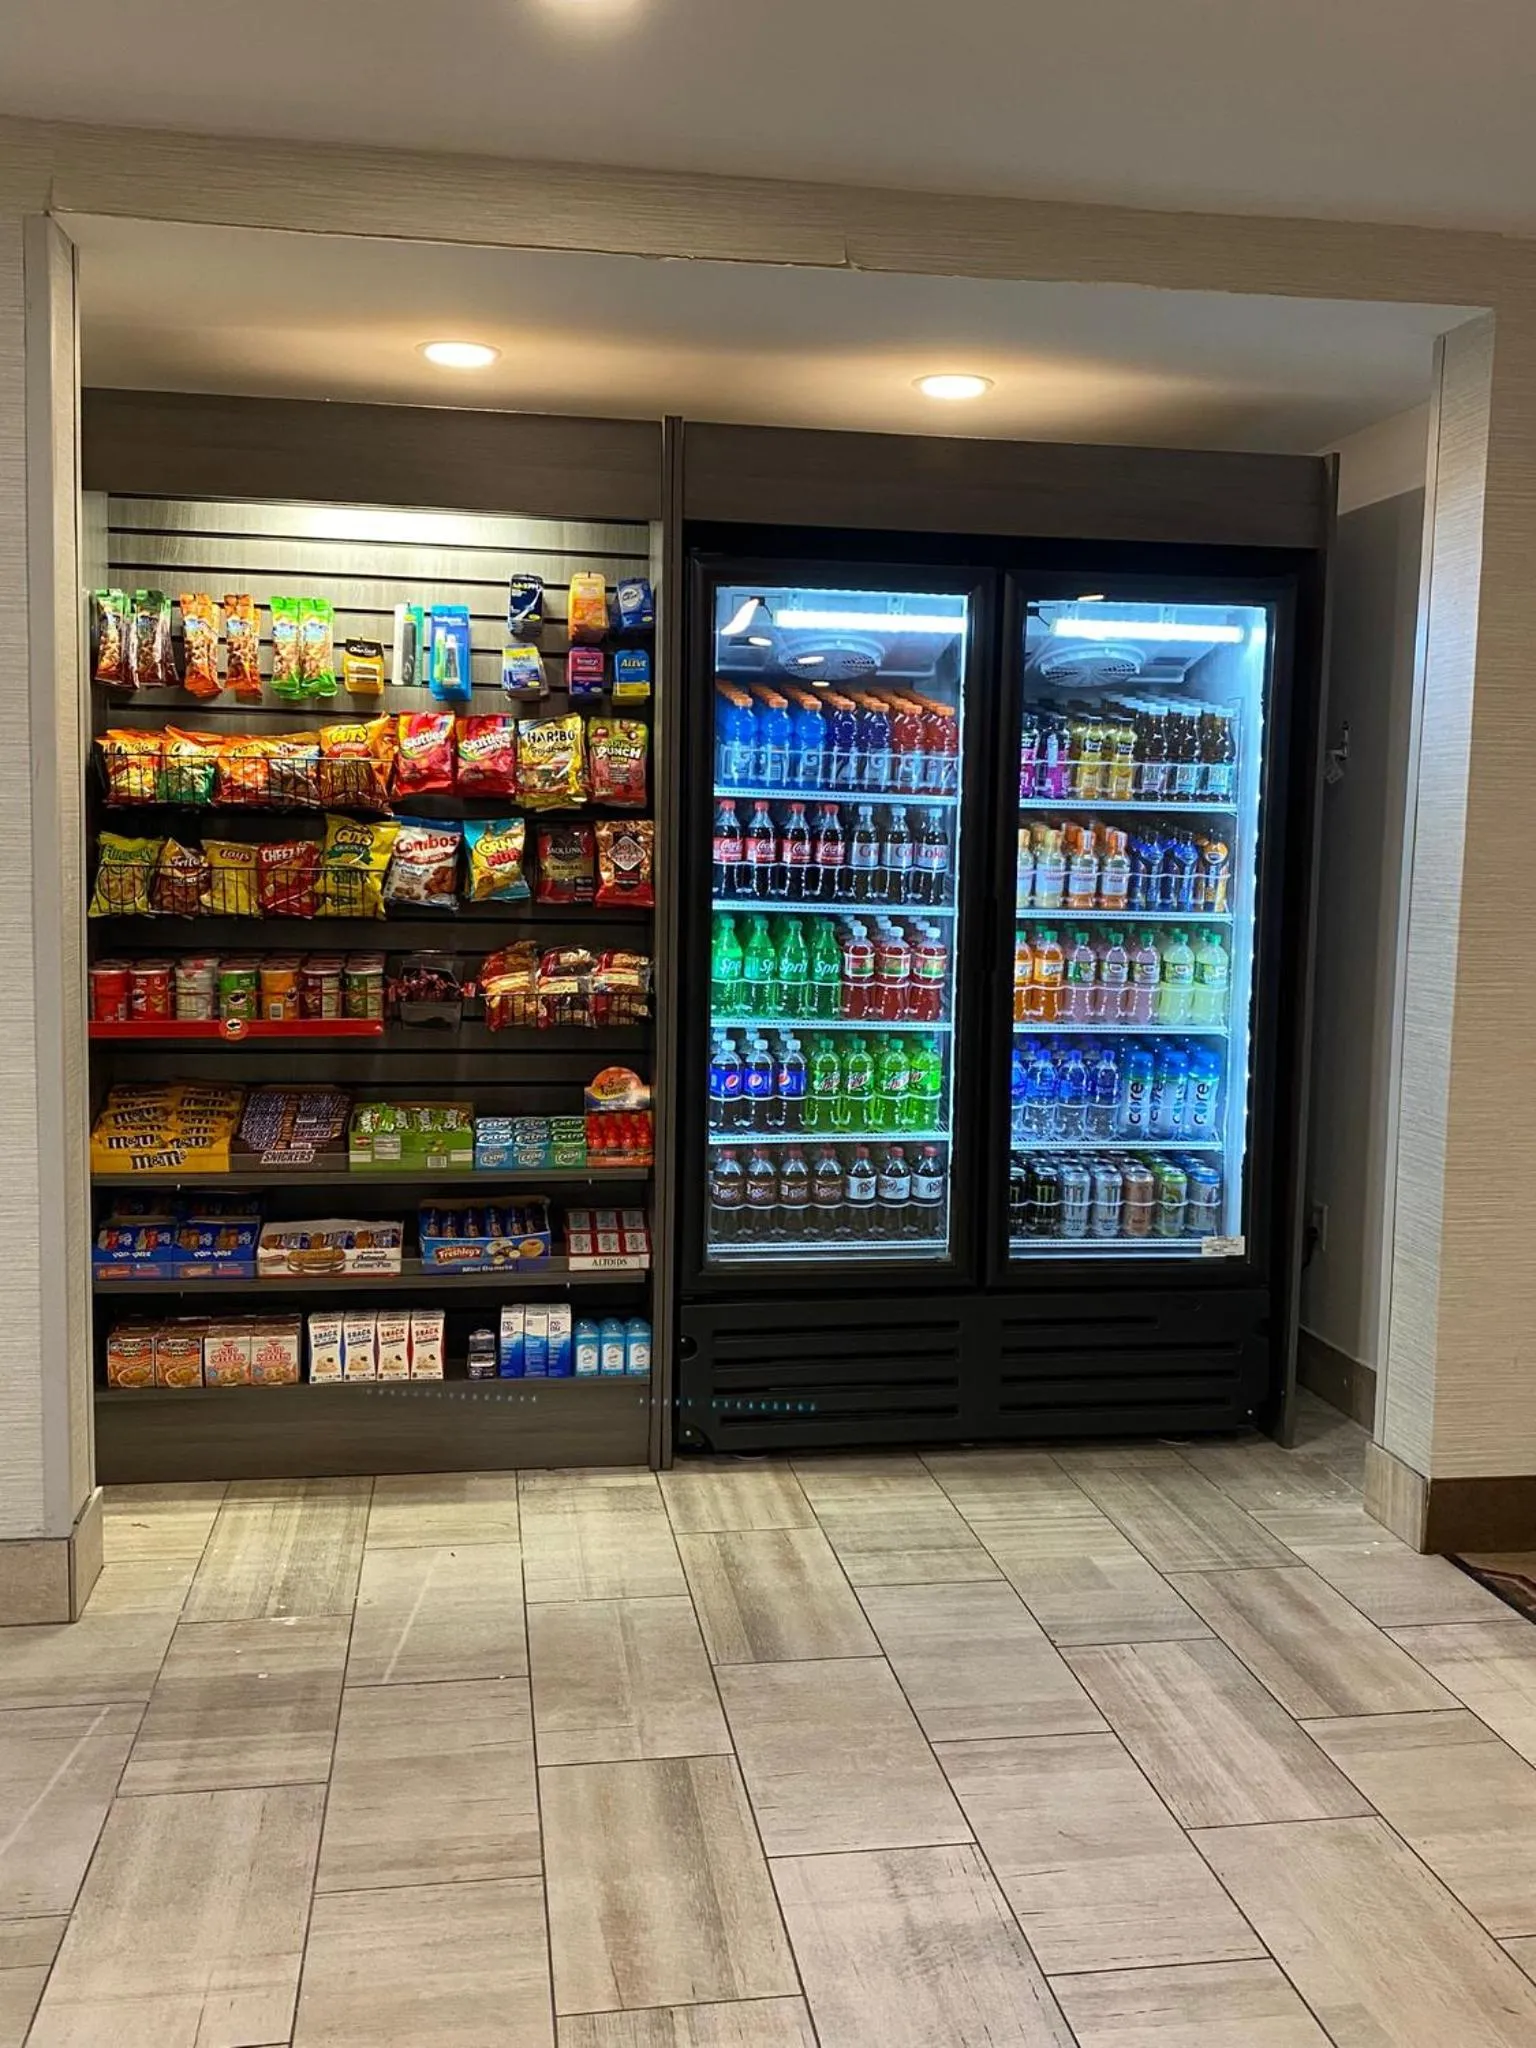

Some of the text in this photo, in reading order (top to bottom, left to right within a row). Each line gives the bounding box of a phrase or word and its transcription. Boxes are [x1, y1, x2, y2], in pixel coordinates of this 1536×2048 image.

[403, 730, 447, 749] Skittles
[463, 732, 512, 751] Skittles
[527, 731, 576, 743] HARIBO
[594, 745, 642, 760] PUNCH
[396, 836, 458, 854] Combos
[1128, 1081, 1144, 1124] core
[1151, 1078, 1164, 1122] core
[1193, 1081, 1210, 1125] core
[263, 1151, 314, 1163] SNICKERS
[438, 1247, 481, 1259] Freshley's
[591, 1258, 628, 1266] ALTOIDS
